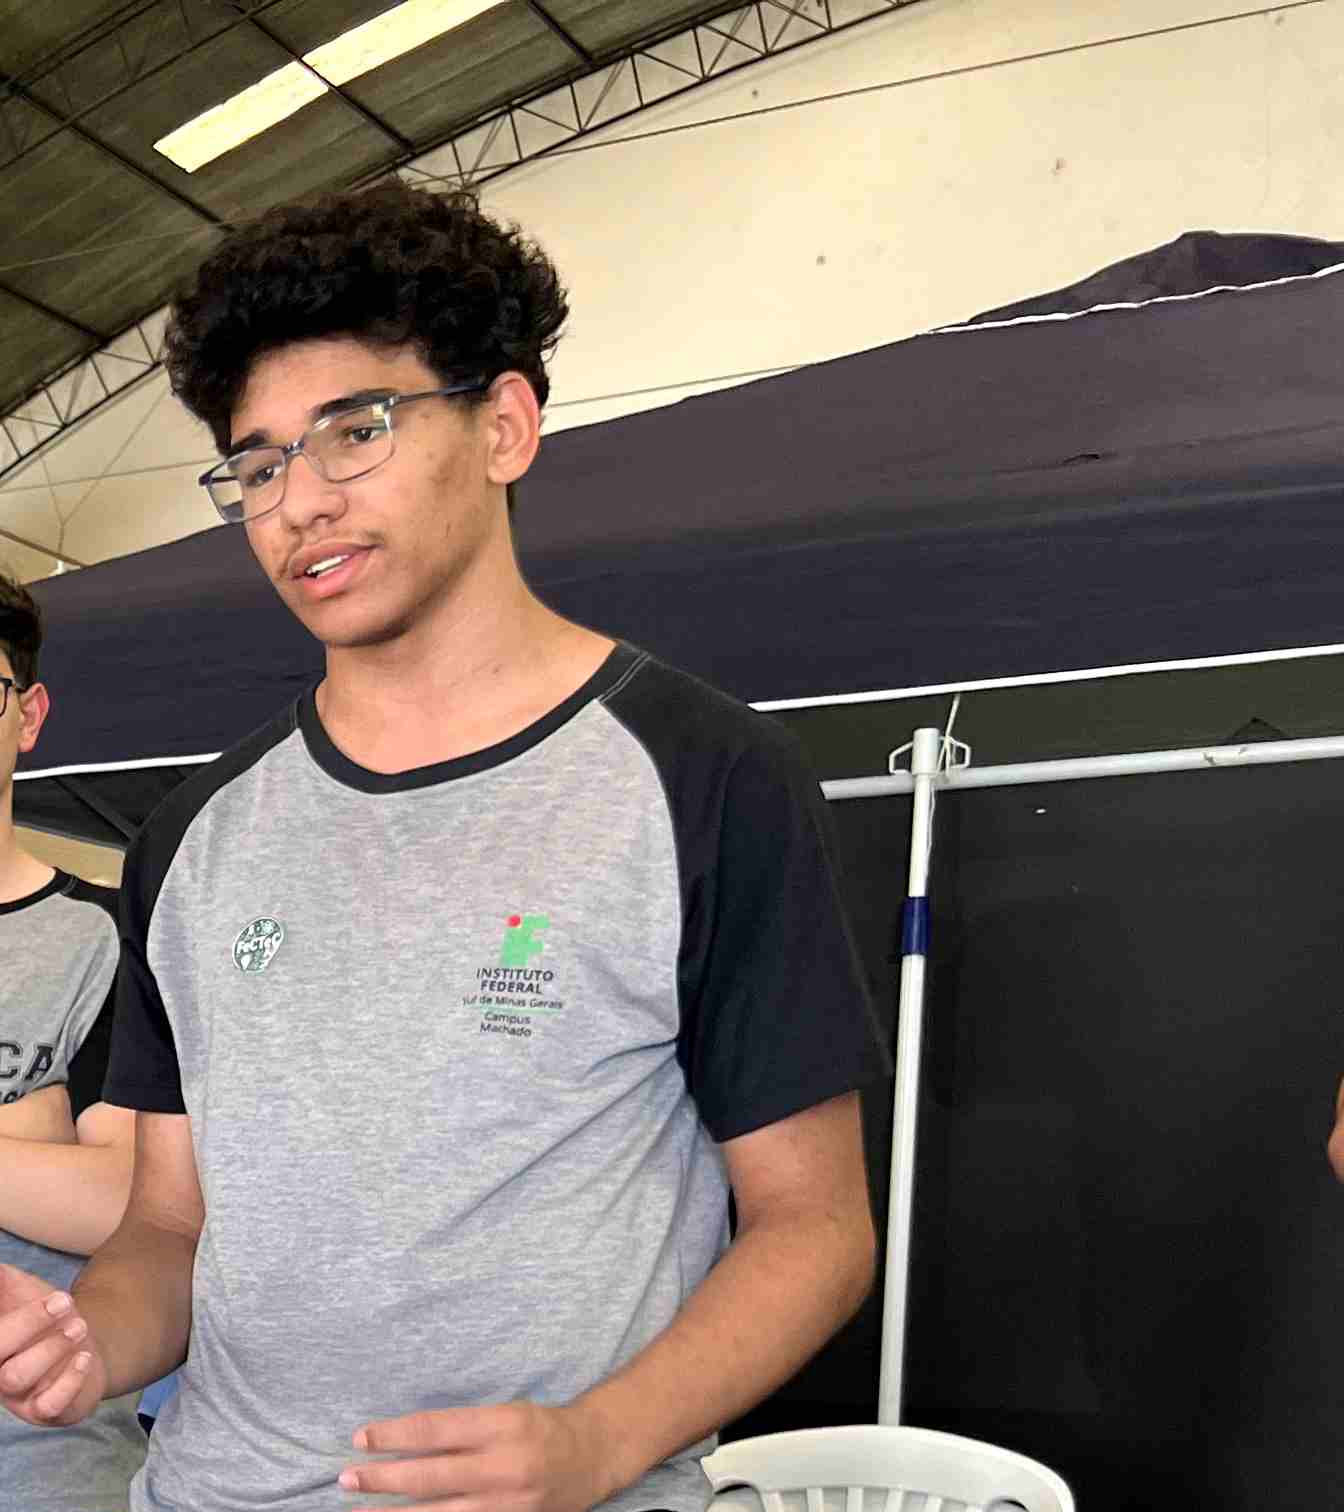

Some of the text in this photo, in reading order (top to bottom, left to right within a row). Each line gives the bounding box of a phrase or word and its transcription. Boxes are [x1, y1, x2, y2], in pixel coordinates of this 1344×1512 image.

[475, 967, 555, 982] INSTITUTO
[479, 980, 543, 995] FEDERAL
[483, 1011, 531, 1026] Campus
